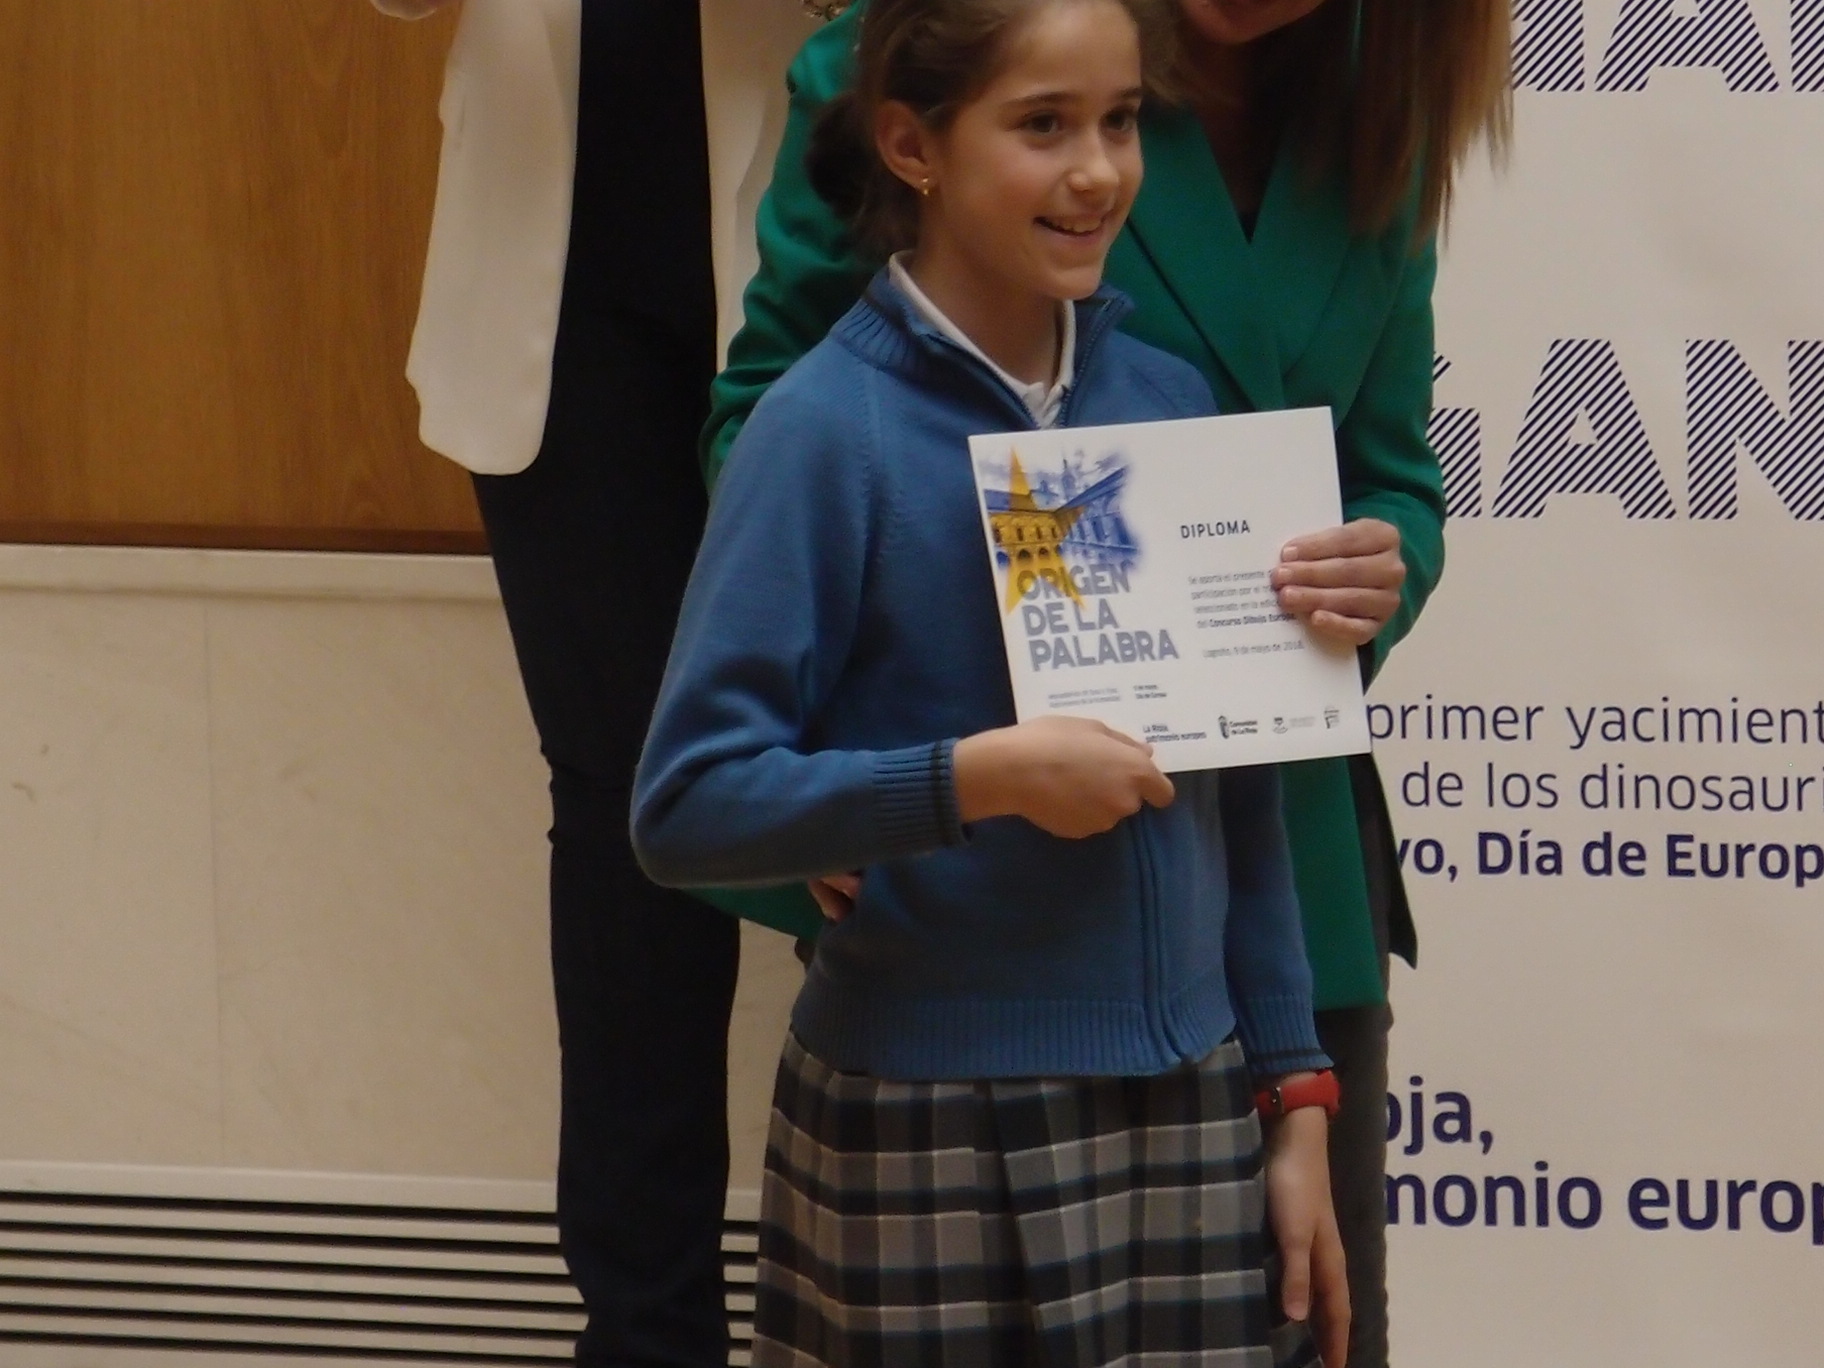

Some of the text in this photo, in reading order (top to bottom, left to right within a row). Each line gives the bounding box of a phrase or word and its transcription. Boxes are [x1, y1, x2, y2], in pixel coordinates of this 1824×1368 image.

[1180, 519, 1251, 539] DIPLOMA
[1017, 562, 1131, 601] ORIGEN
[1022, 598, 1120, 637] DE LA
[1028, 629, 1180, 672] PALABRA
[1366, 694, 1544, 742] primer
[1402, 761, 1463, 808] de
[1487, 762, 1559, 809] los
[1477, 829, 1563, 877] Día
[1582, 831, 1647, 878] de
